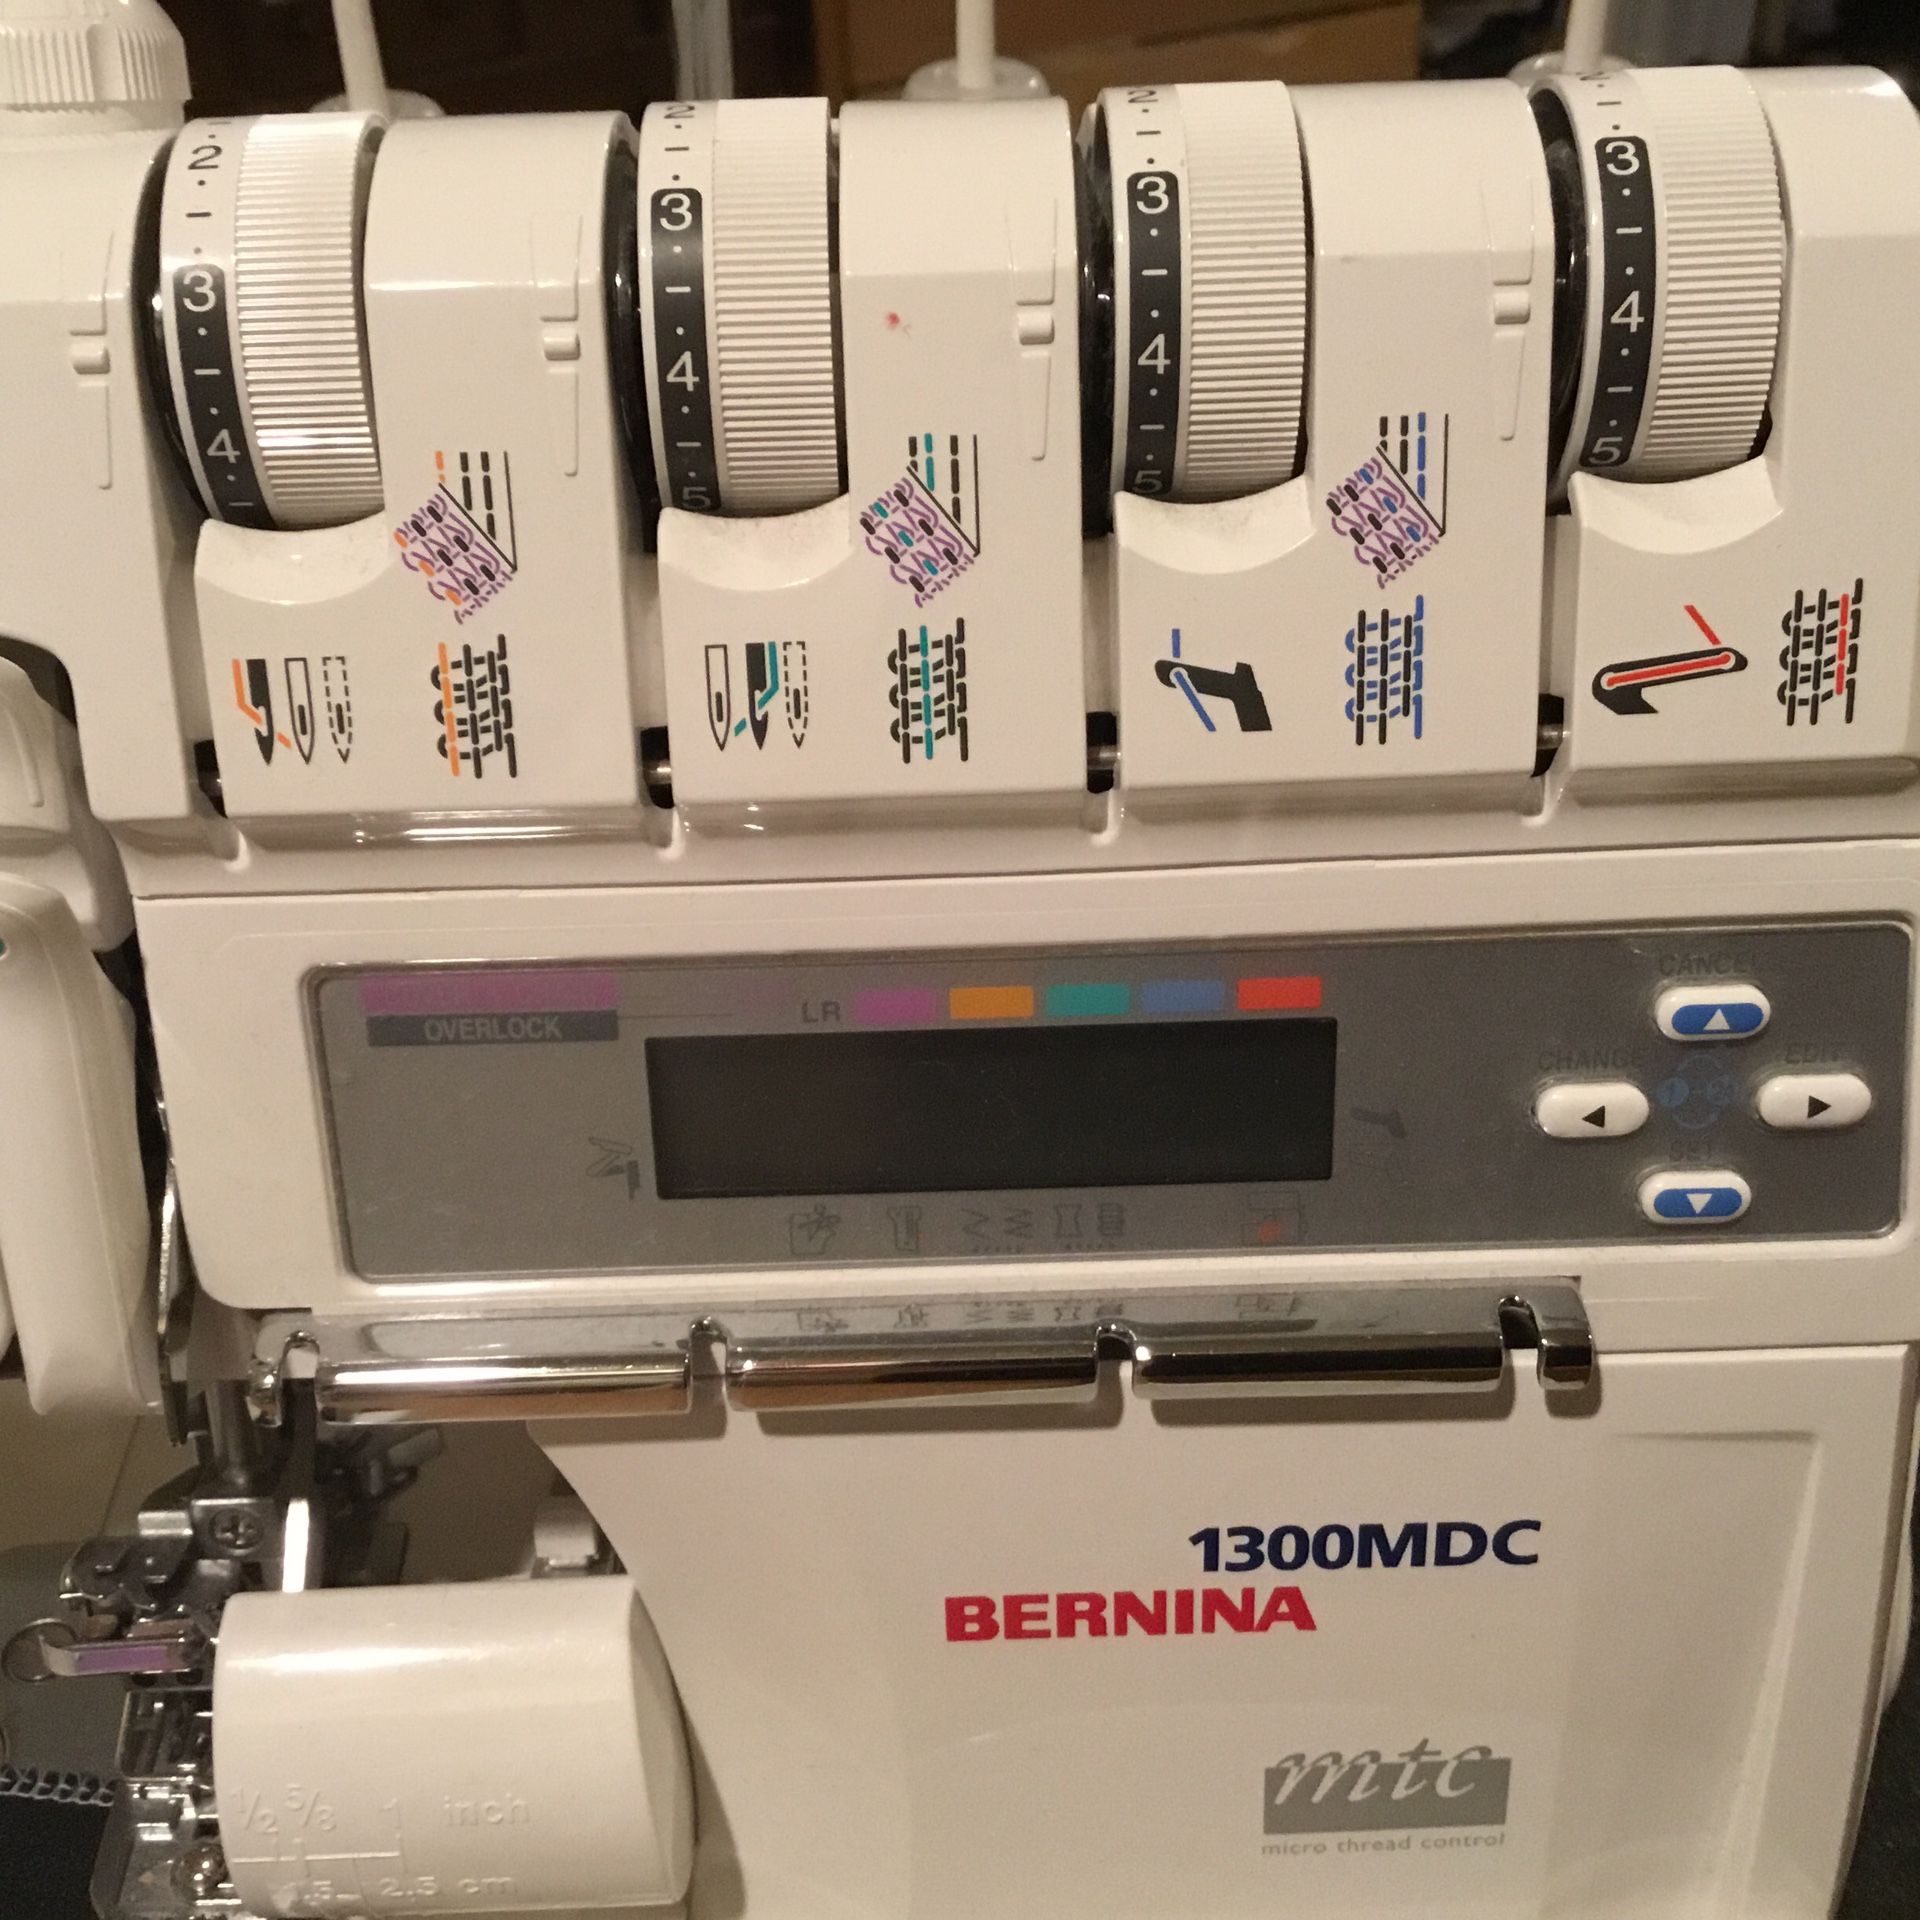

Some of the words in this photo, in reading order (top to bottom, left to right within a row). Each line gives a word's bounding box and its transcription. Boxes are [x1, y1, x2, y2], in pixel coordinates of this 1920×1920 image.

[663, 104, 695, 119] 2
[1127, 89, 1158, 103] 2
[187, 144, 223, 171] 2
[1605, 140, 1641, 176] 3
[659, 192, 693, 232] 3
[1136, 175, 1170, 215] 3
[182, 270, 217, 313] 3
[1610, 291, 1645, 333] 4
[666, 350, 700, 392] 4
[1137, 333, 1171, 375] 4
[206, 428, 241, 464] 4
[1587, 436, 1624, 466] 5
[682, 486, 712, 510] 5
[1132, 469, 1163, 494] 5
[423, 1015, 563, 1043] OVERLOCK
[1187, 1519, 1542, 1573] 1300MDC
[944, 1585, 1318, 1642] BERNINA
[1274, 1737, 1494, 1805] mtc
[444, 1792, 531, 1826] inch
[1261, 1839, 1328, 1856] micro
[1336, 1836, 1412, 1853] thread
[1420, 1832, 1505, 1850] control
[458, 1876, 516, 1896] cm
